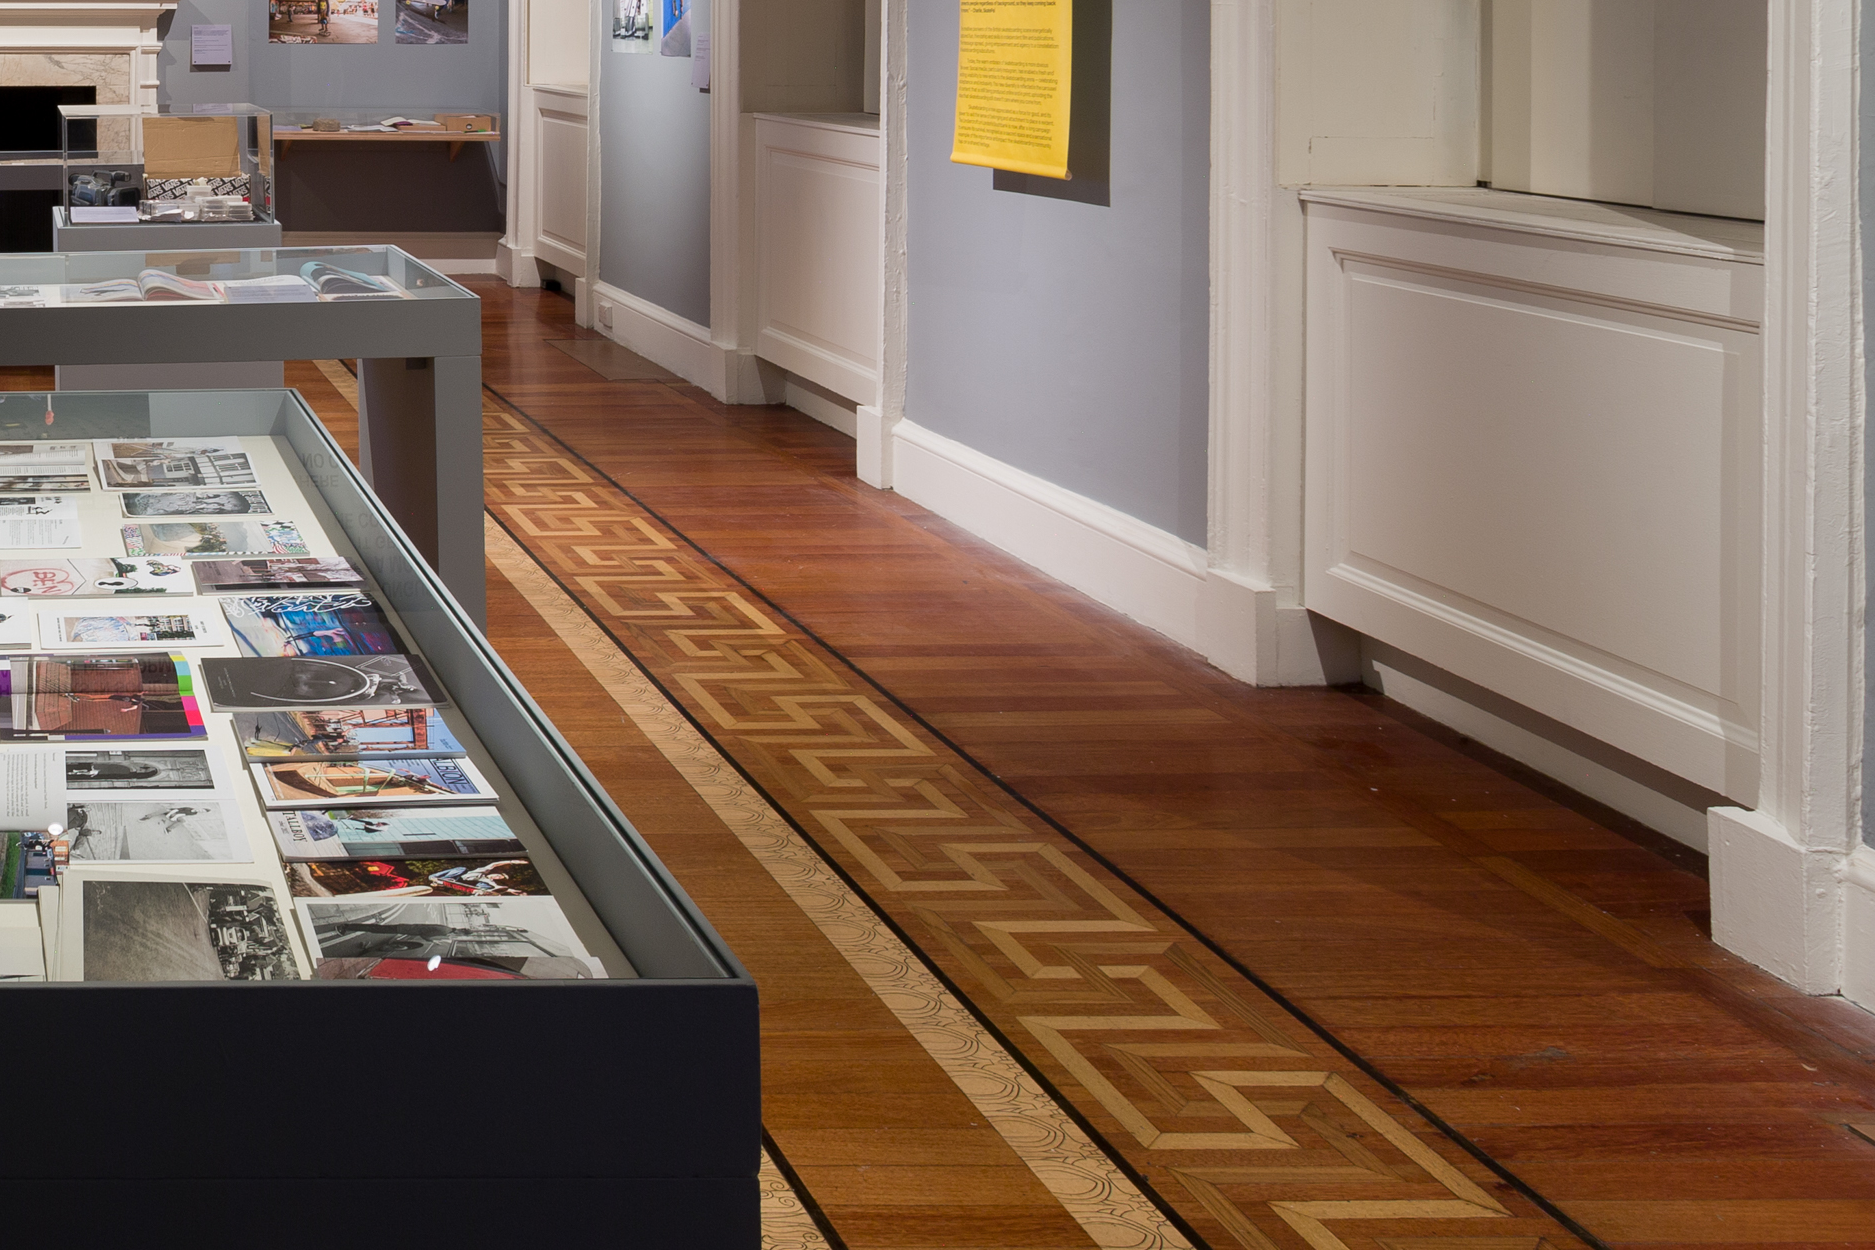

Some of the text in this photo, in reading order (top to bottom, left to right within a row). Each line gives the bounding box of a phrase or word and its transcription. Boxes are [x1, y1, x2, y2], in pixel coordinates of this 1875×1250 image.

[161, 179, 180, 191] VANS
[215, 185, 233, 196] VANS
[33, 571, 62, 594] BEN
[282, 810, 308, 843] TALLBOY
